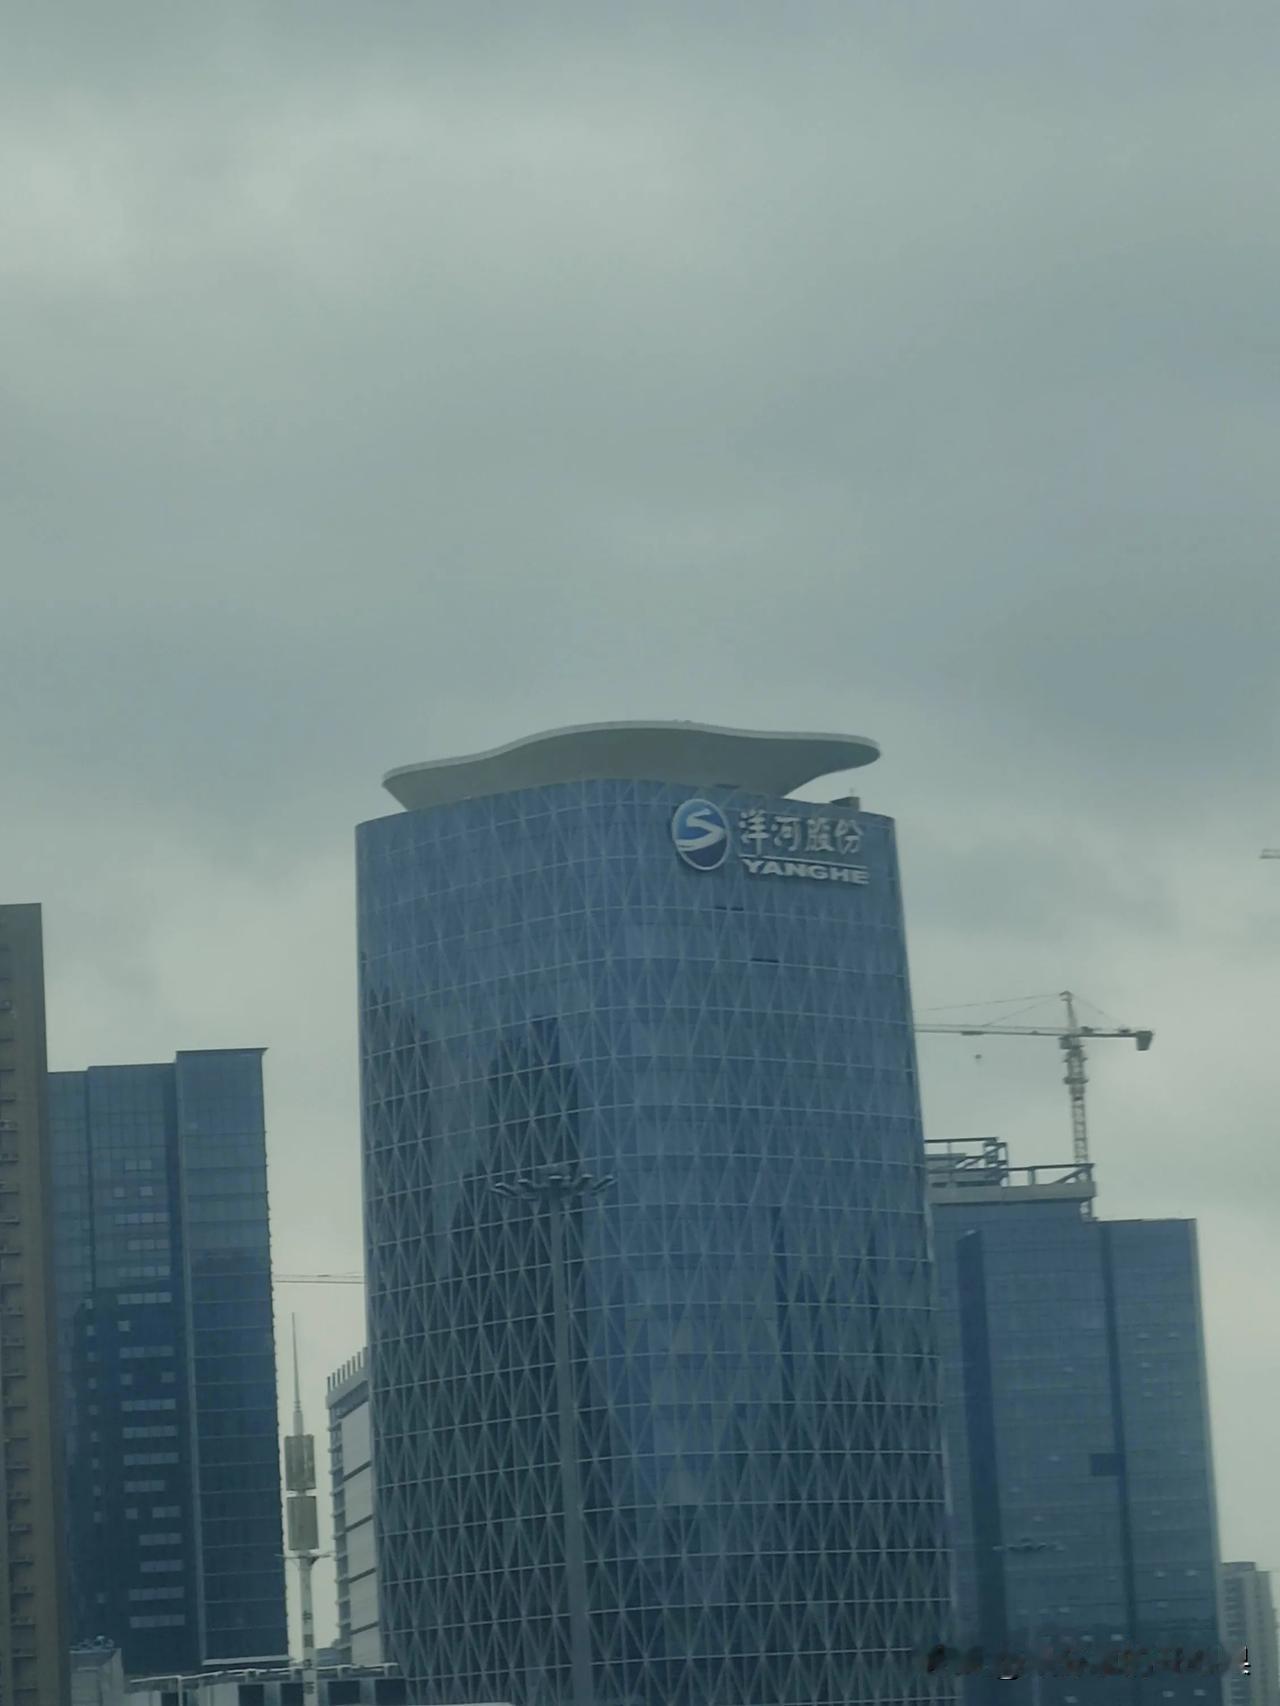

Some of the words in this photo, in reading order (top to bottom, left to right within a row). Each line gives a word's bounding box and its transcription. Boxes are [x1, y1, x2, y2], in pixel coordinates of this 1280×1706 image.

[739, 809, 864, 855] 洋河股份
[742, 859, 869, 884] YANGHE
